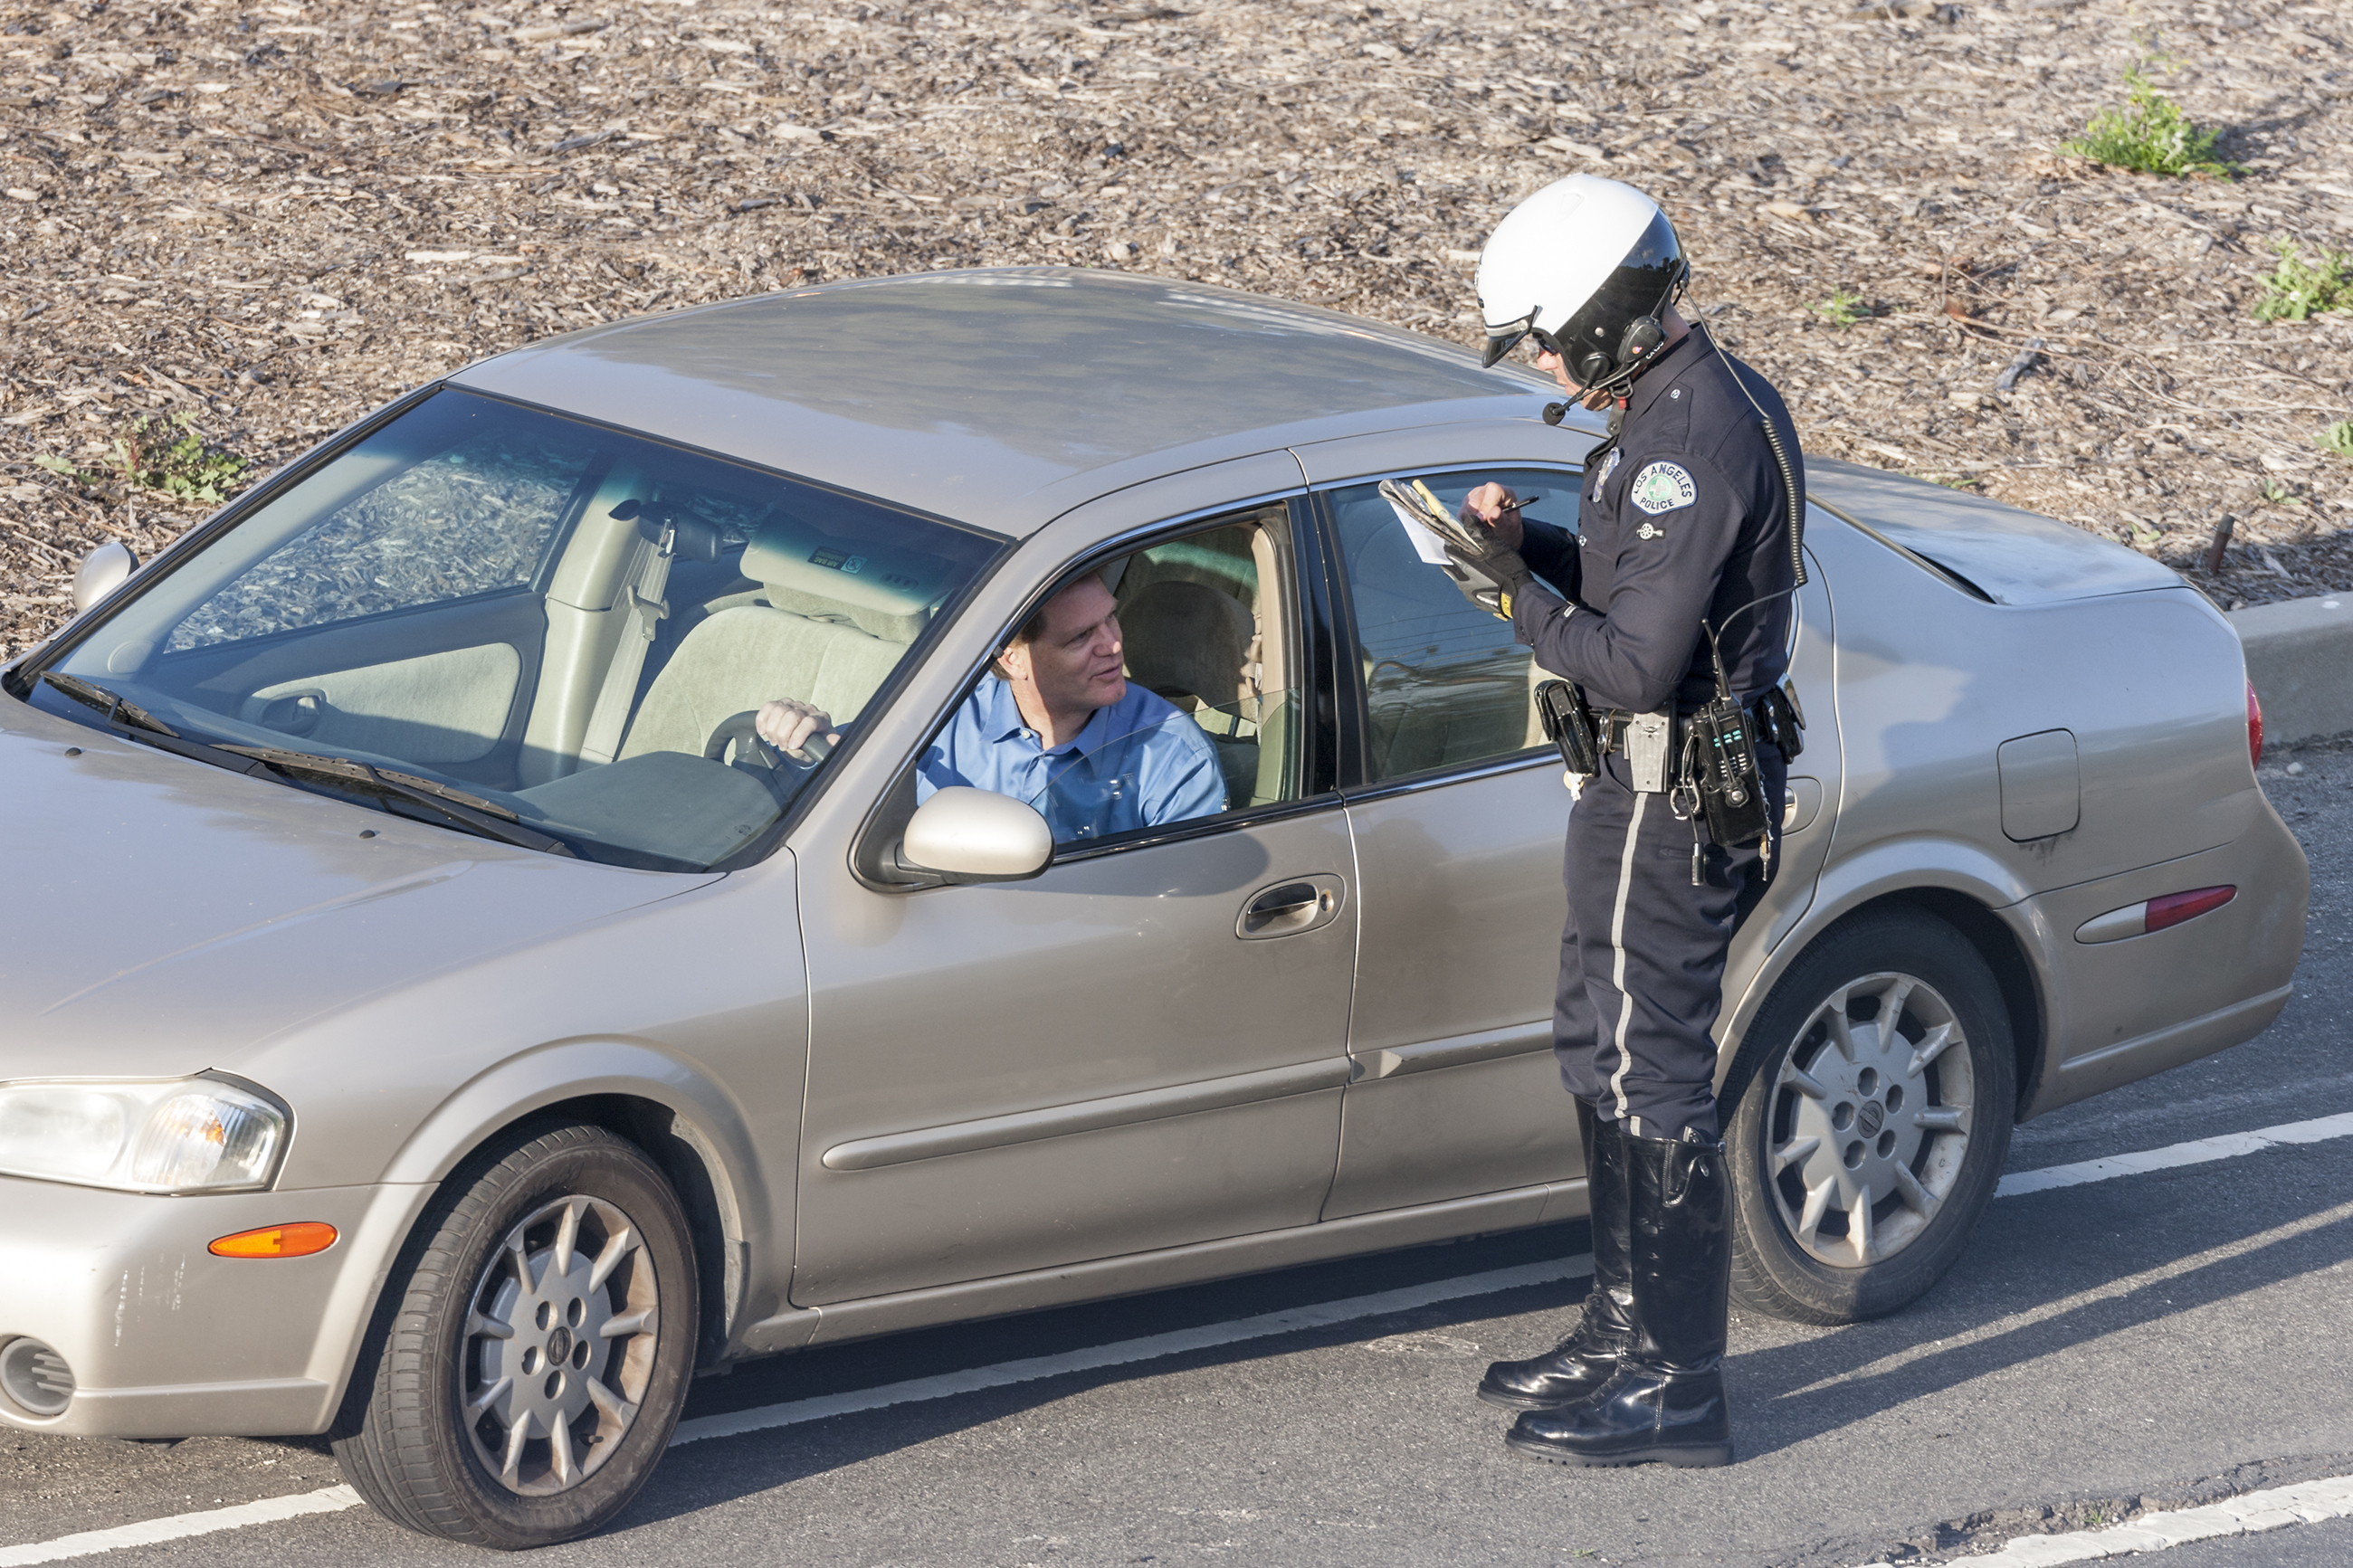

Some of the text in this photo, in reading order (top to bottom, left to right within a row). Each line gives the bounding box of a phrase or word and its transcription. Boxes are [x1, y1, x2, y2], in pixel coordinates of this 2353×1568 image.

[1634, 464, 1692, 498] LOS ANGELES
[1640, 497, 1674, 510] POLICE
